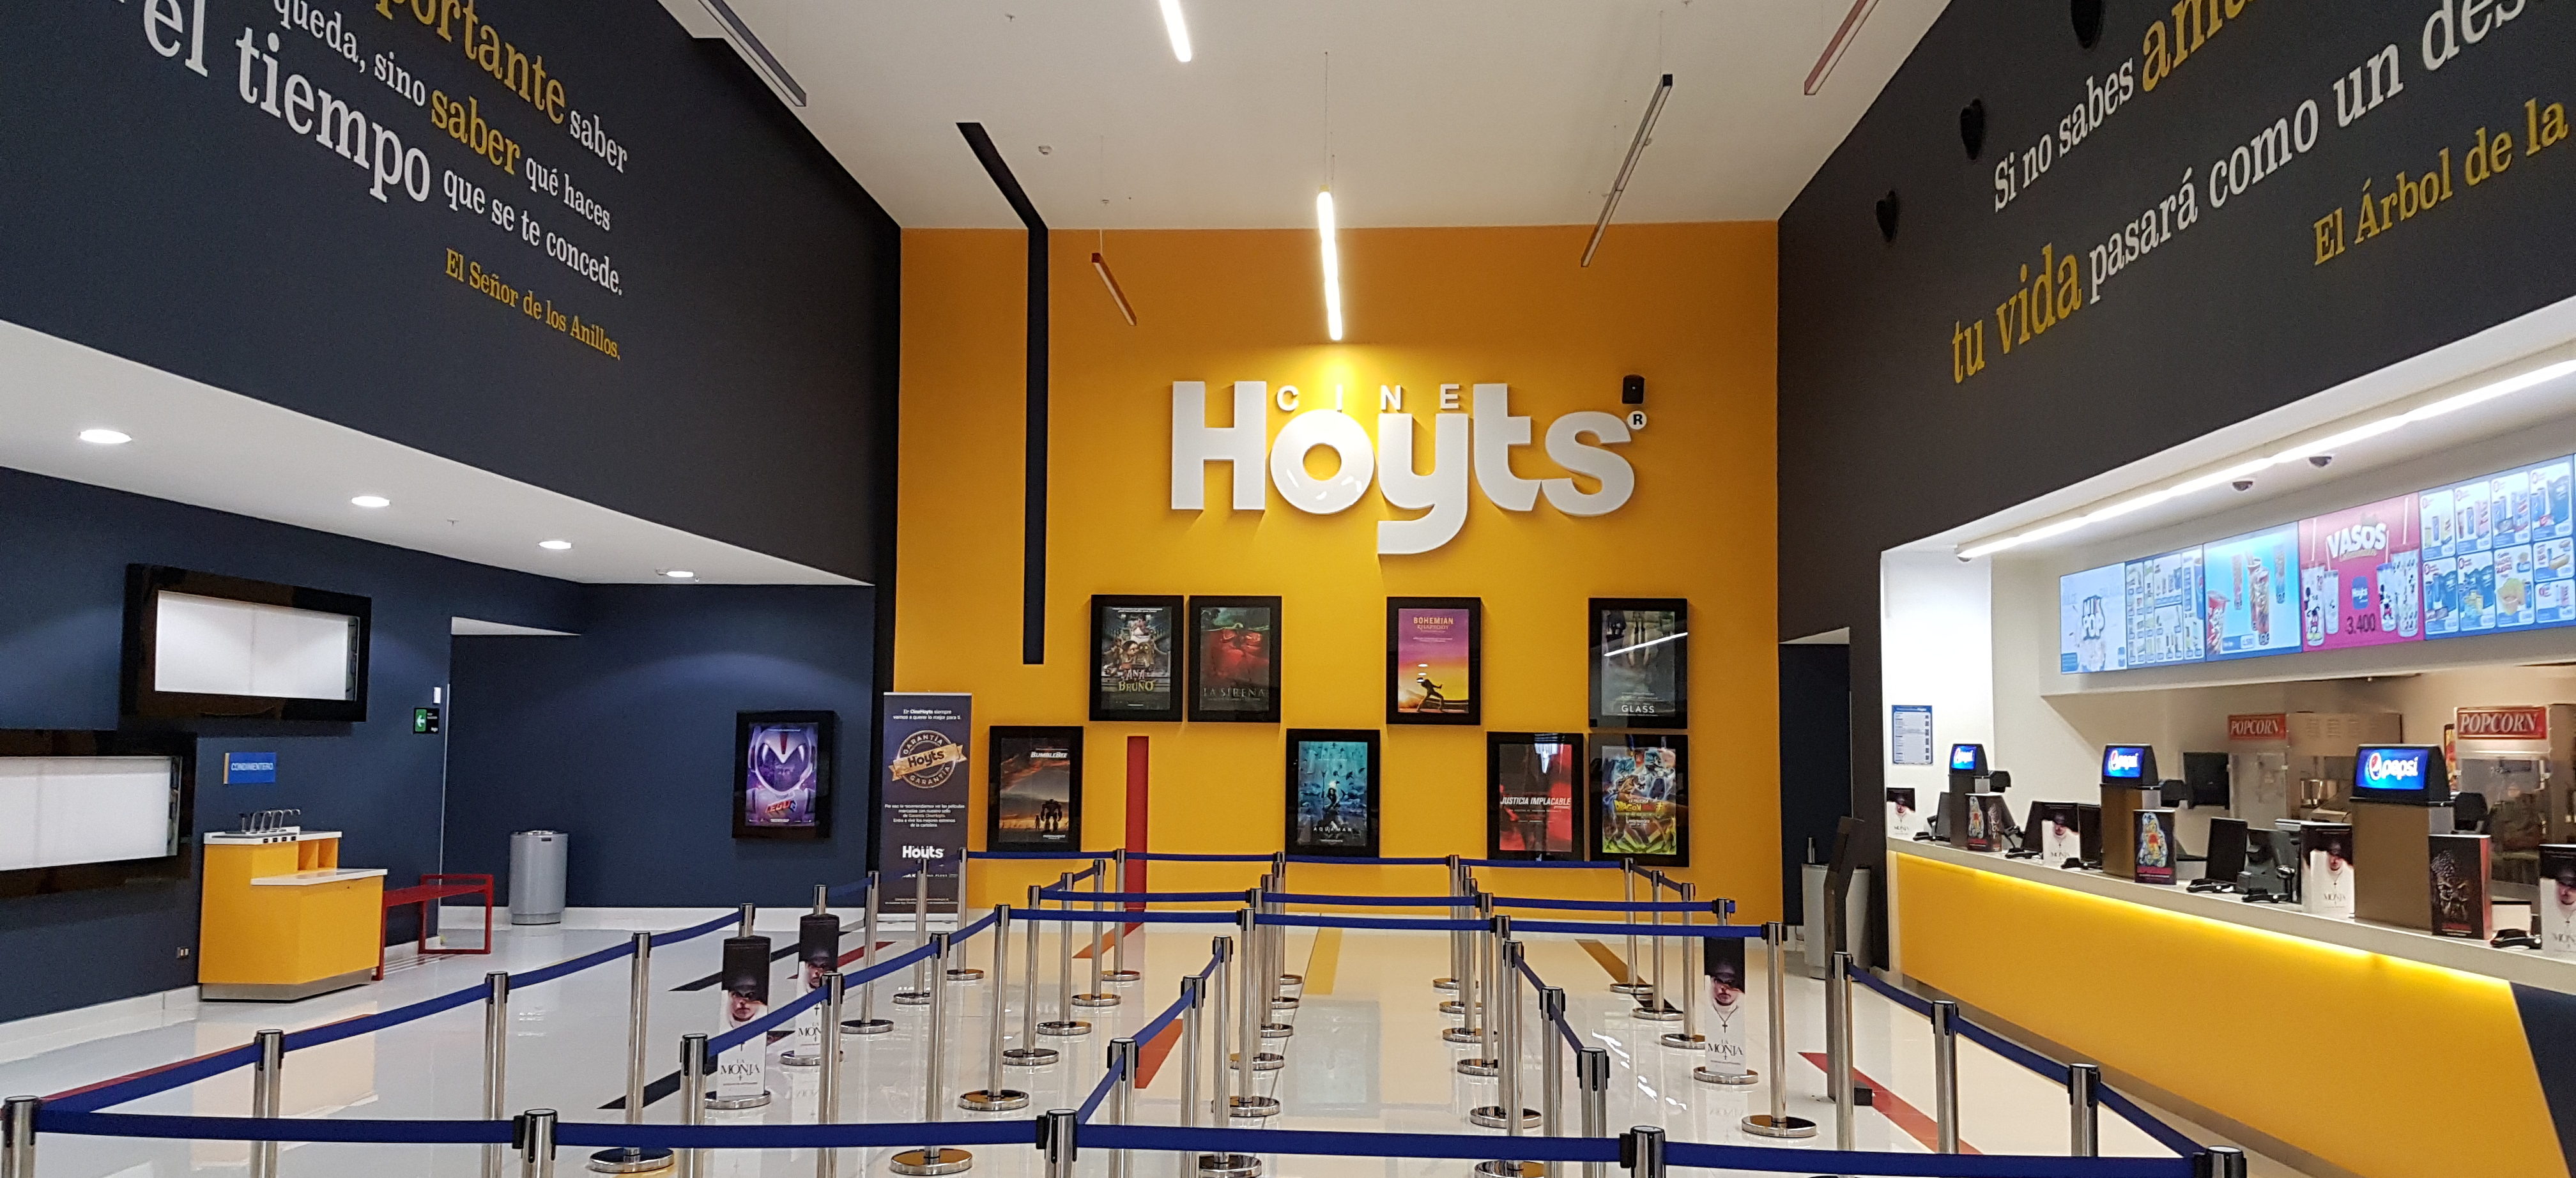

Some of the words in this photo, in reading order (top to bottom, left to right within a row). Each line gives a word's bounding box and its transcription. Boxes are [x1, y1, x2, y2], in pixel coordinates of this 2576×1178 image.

[376, 0, 565, 124] ortante
[571, 110, 627, 173] saber
[274, 0, 365, 73] queda,
[374, 51, 425, 106] sino
[431, 89, 521, 174] saber
[526, 157, 558, 196] qué
[564, 172, 610, 231] haces
[1994, 151, 2016, 213] Si
[2022, 134, 2051, 188] no
[2058, 57, 2134, 158] sabes
[144, 0, 208, 77] el
[235, 27, 430, 203] tiempo
[443, 169, 486, 211] que
[491, 199, 515, 231] se
[521, 210, 540, 246] te
[546, 233, 622, 296] concede.
[2313, 207, 2345, 266] El
[2354, 148, 2453, 244] Árbol
[2465, 127, 2513, 185] de
[2526, 98, 2568, 157] la
[1952, 320, 1985, 384] tu
[1997, 243, 2082, 354] vida
[2089, 167, 2198, 305] pasará
[2209, 99, 2319, 208] como
[2333, 43, 2404, 127] un
[445, 247, 464, 282] El
[469, 261, 519, 307] Señor
[523, 290, 542, 320] de
[546, 300, 566, 332] los
[570, 315, 621, 361] Anillos.
[1276, 383, 1459, 411] CINE
[1170, 381, 1636, 555] Hoyts
[2326, 523, 2386, 558] VASOS
[2345, 613, 2376, 634] 3.400
[1126, 668, 1145, 680] ANA
[1621, 705, 1655, 713] GLASS
[2231, 720, 2279, 735] POPCORN
[2460, 713, 2538, 733] POPCORN
[907, 751, 944, 768] Hoyts
[2382, 756, 2418, 780] pepsi
[1500, 797, 1529, 805] JUSTICIA
[902, 845, 944, 859] Hoyts
[798, 1027, 822, 1036] MON
[1708, 1043, 1743, 1056] MONJA
[721, 1064, 760, 1076] MONJA
